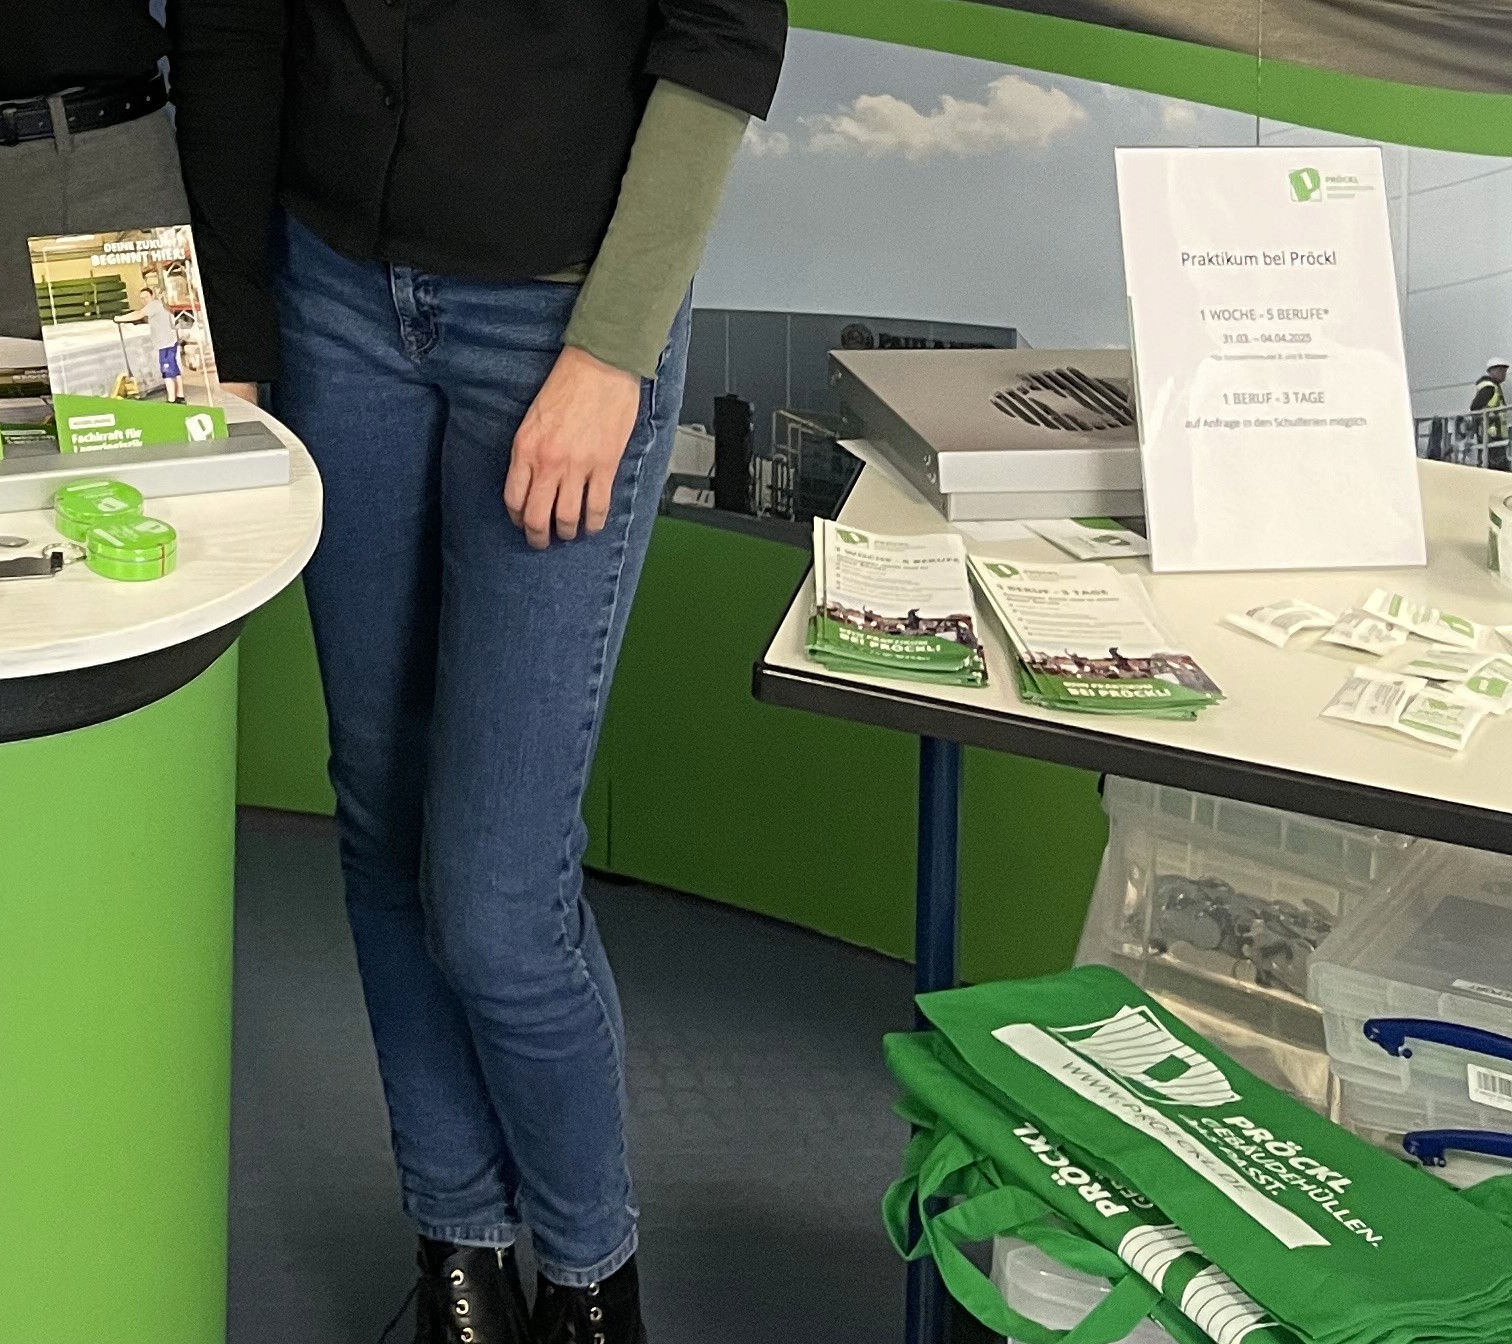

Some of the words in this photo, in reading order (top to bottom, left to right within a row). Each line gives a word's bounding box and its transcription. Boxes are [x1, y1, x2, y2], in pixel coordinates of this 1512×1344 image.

[104, 242, 135, 254] DEINE
[91, 253, 148, 267] BEGINNT
[151, 248, 186, 261] HIER!
[1181, 251, 1258, 267] Praktikum
[1263, 251, 1285, 266] bei
[1291, 250, 1337, 266] Pröckl
[1209, 309, 1257, 321] WOCHE
[1233, 392, 1273, 404] BERUF
[1283, 392, 1290, 403] 3
[1293, 392, 1325, 403] TAGE
[1223, 1116, 1352, 1194] PRÖCKL
[1013, 1122, 1129, 1218] PRÖCKL
[1201, 1117, 1384, 1248] GEBÄUDEHÜLLEN.
